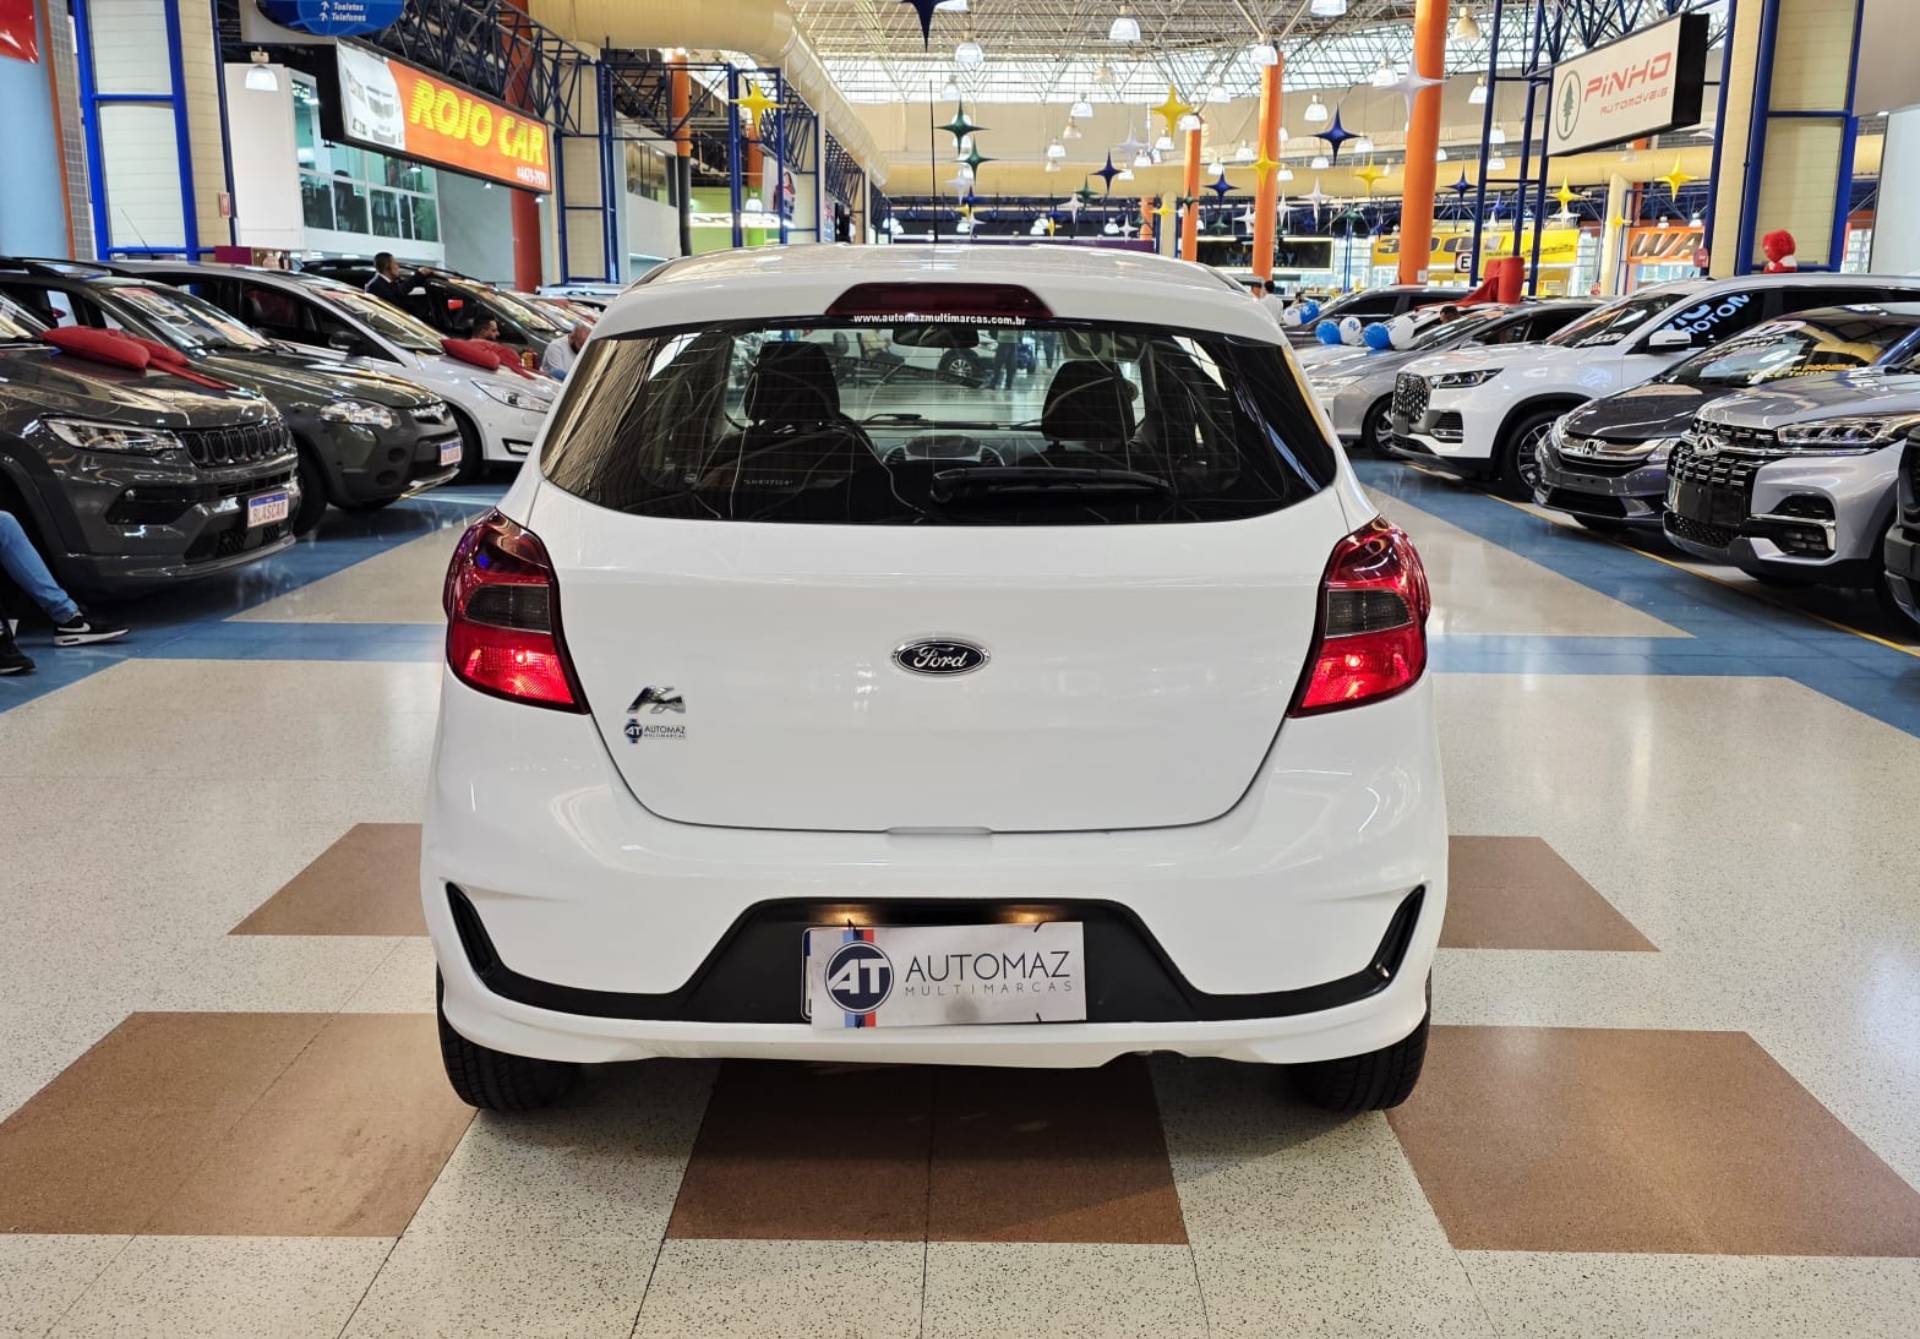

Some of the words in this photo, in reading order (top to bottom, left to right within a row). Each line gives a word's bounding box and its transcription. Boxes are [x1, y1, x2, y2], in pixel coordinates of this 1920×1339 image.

[1584, 51, 1672, 102] PINHO
[408, 78, 493, 147] ROJO
[498, 114, 544, 166] CAR
[913, 646, 967, 668] Ford
[644, 725, 686, 734] AUTOMAZ
[828, 957, 891, 995] AT
[905, 950, 1071, 983] AUTOMAZ
[905, 980, 1073, 997] MULTIMARCAS
